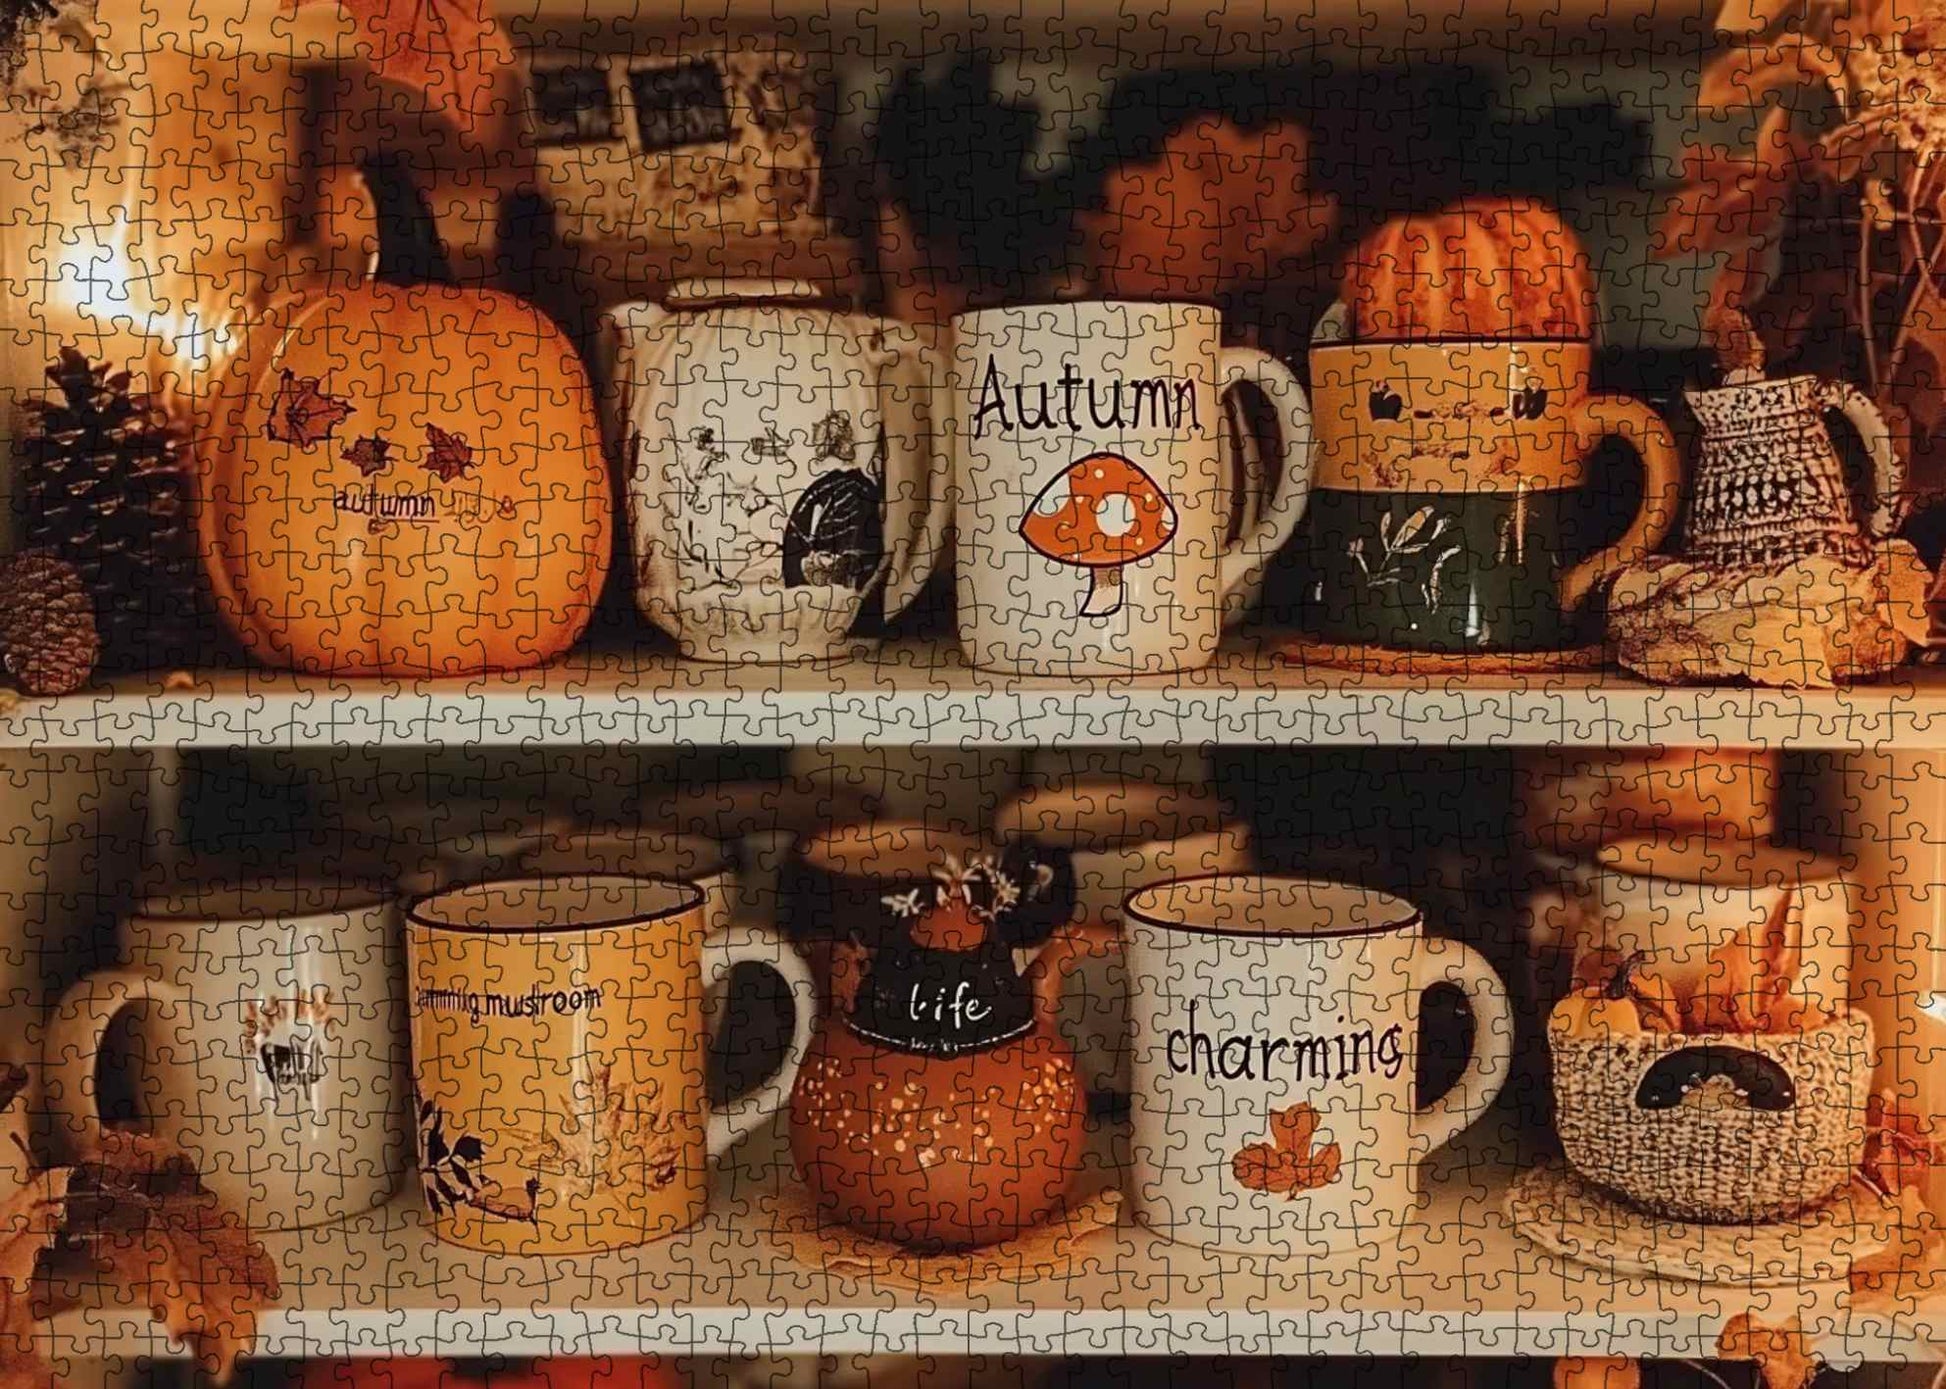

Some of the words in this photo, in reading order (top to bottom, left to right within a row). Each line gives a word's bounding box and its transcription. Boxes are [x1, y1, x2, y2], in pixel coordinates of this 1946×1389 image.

[973, 353, 1201, 440] Autumn
[334, 483, 436, 518] autumn
[1167, 998, 1403, 1082] charming
